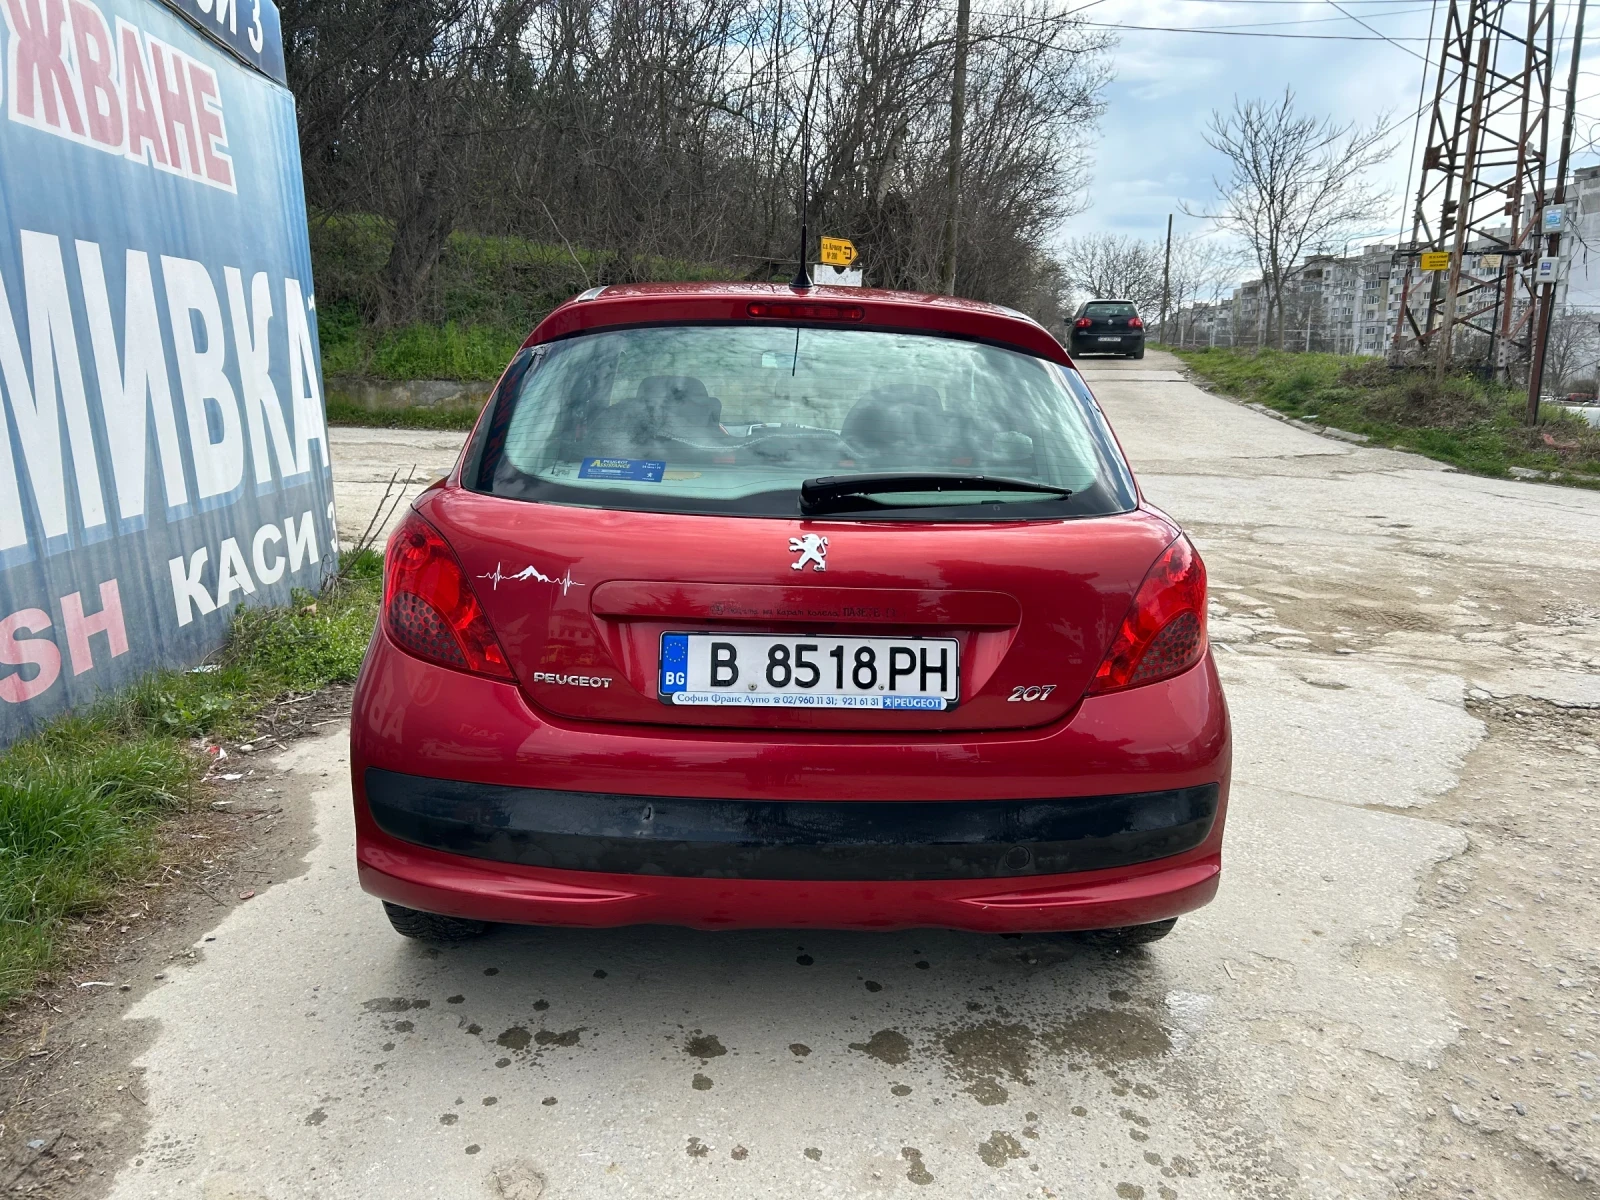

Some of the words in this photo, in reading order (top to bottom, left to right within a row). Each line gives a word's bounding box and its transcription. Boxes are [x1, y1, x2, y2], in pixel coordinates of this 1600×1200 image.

[168, 510, 319, 627] КАСИ
[0, 578, 129, 703] SH
[710, 642, 739, 687] B
[533, 671, 613, 689] PEUGEOT
[665, 671, 685, 685] BG
[782, 695, 815, 706] 02/960
[817, 696, 824, 706] 11
[842, 696, 857, 706] 921
[860, 697, 868, 706] 61
[870, 697, 879, 707] 31
[1007, 684, 1057, 702] 207
[894, 697, 941, 709] PEUGEOT
